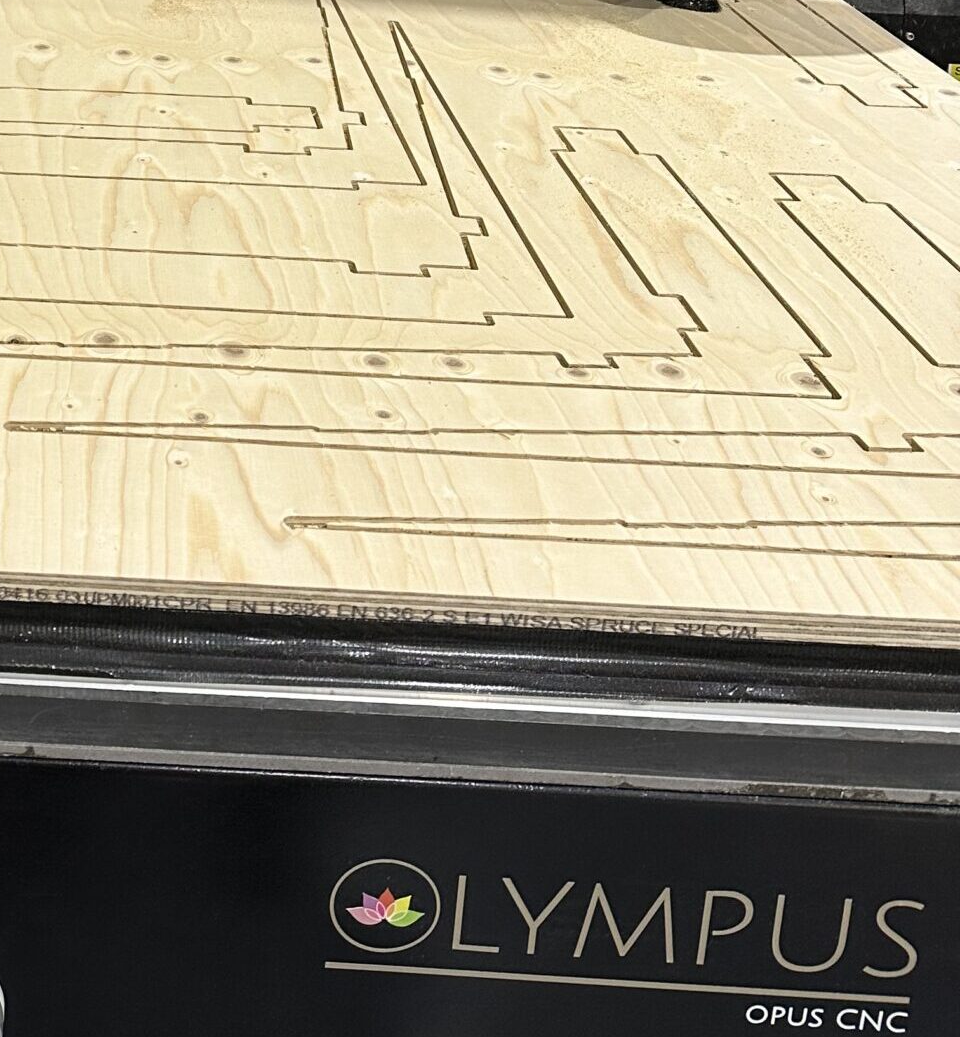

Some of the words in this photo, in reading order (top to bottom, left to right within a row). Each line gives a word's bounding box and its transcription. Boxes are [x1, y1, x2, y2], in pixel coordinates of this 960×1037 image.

[500, 612, 562, 630] WISA
[570, 616, 664, 634] SPRUCE
[674, 623, 763, 640] SPECIAL
[745, 1005, 824, 1028] OPUS
[836, 1008, 909, 1034] CNC
